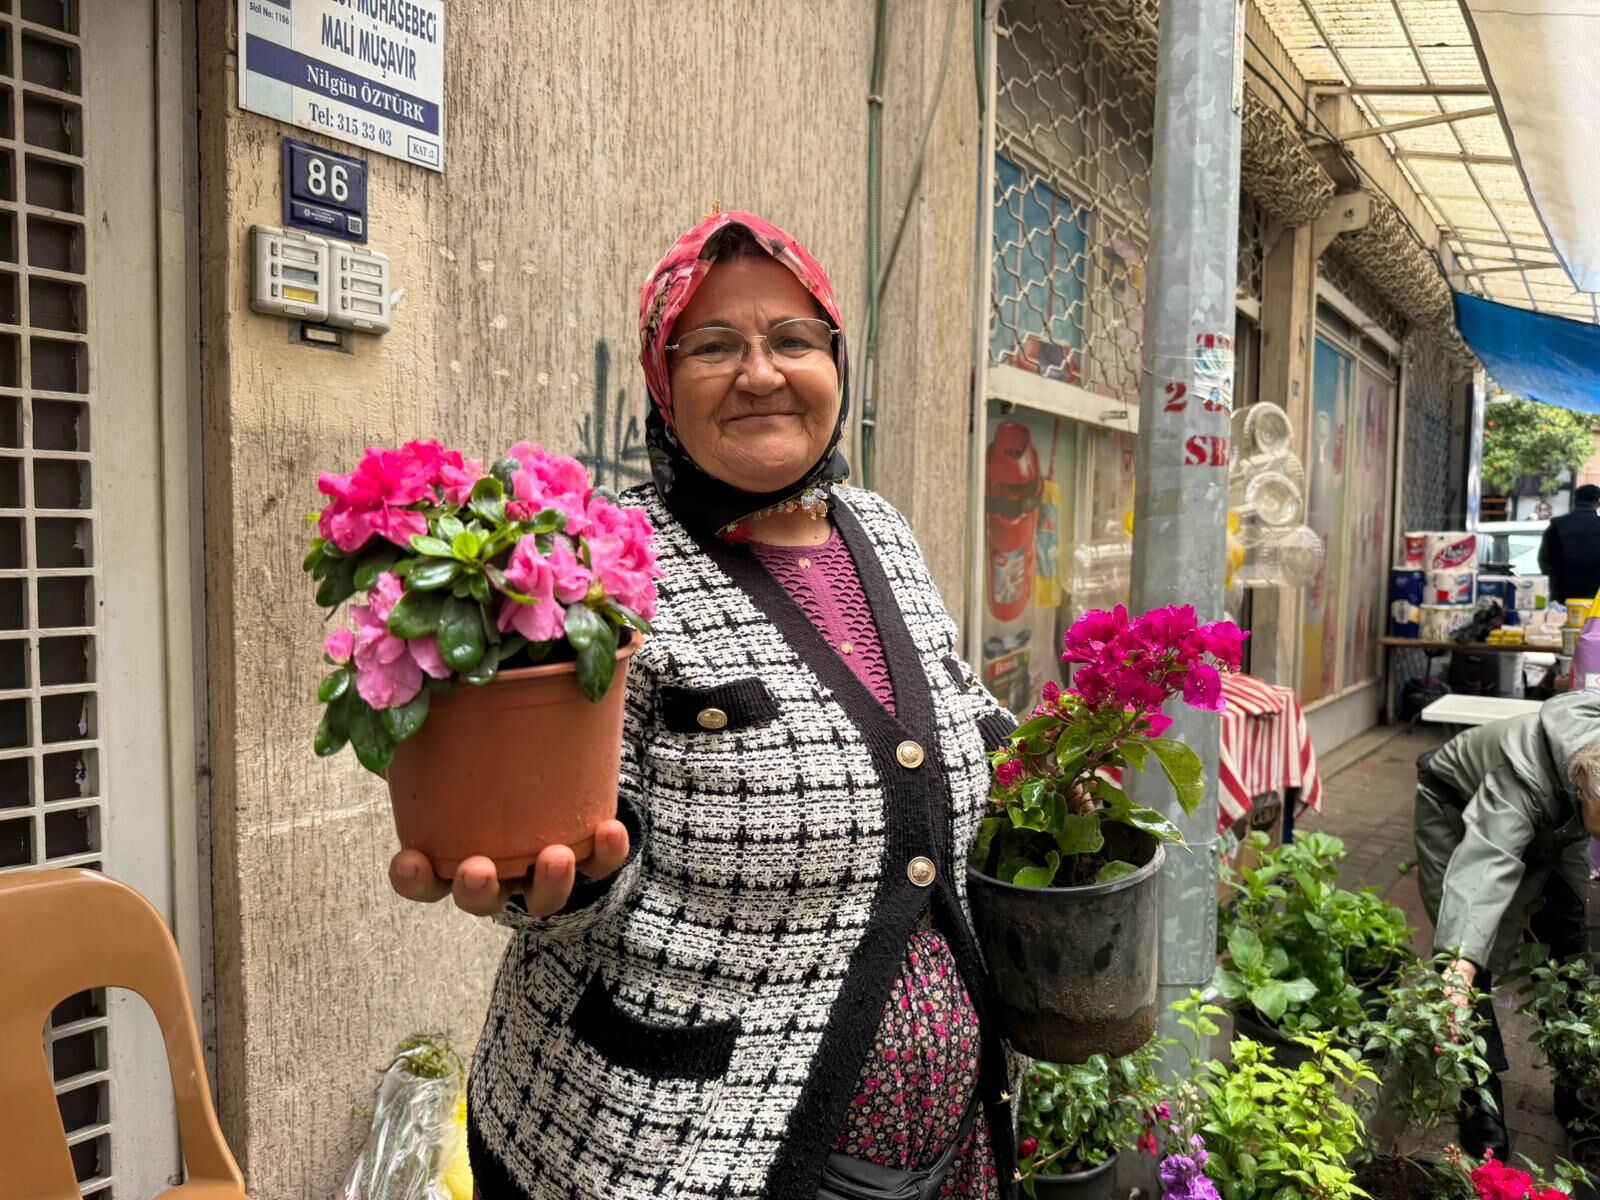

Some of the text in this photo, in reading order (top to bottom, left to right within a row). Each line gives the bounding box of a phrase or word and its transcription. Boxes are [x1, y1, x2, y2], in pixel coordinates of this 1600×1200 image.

[321, 13, 417, 81] MALİ MÜŞAVİR
[306, 64, 425, 123] Nilgün ÖZTÜRK
[309, 102, 392, 147] Tel: 315 33 03
[307, 158, 349, 202] 86
